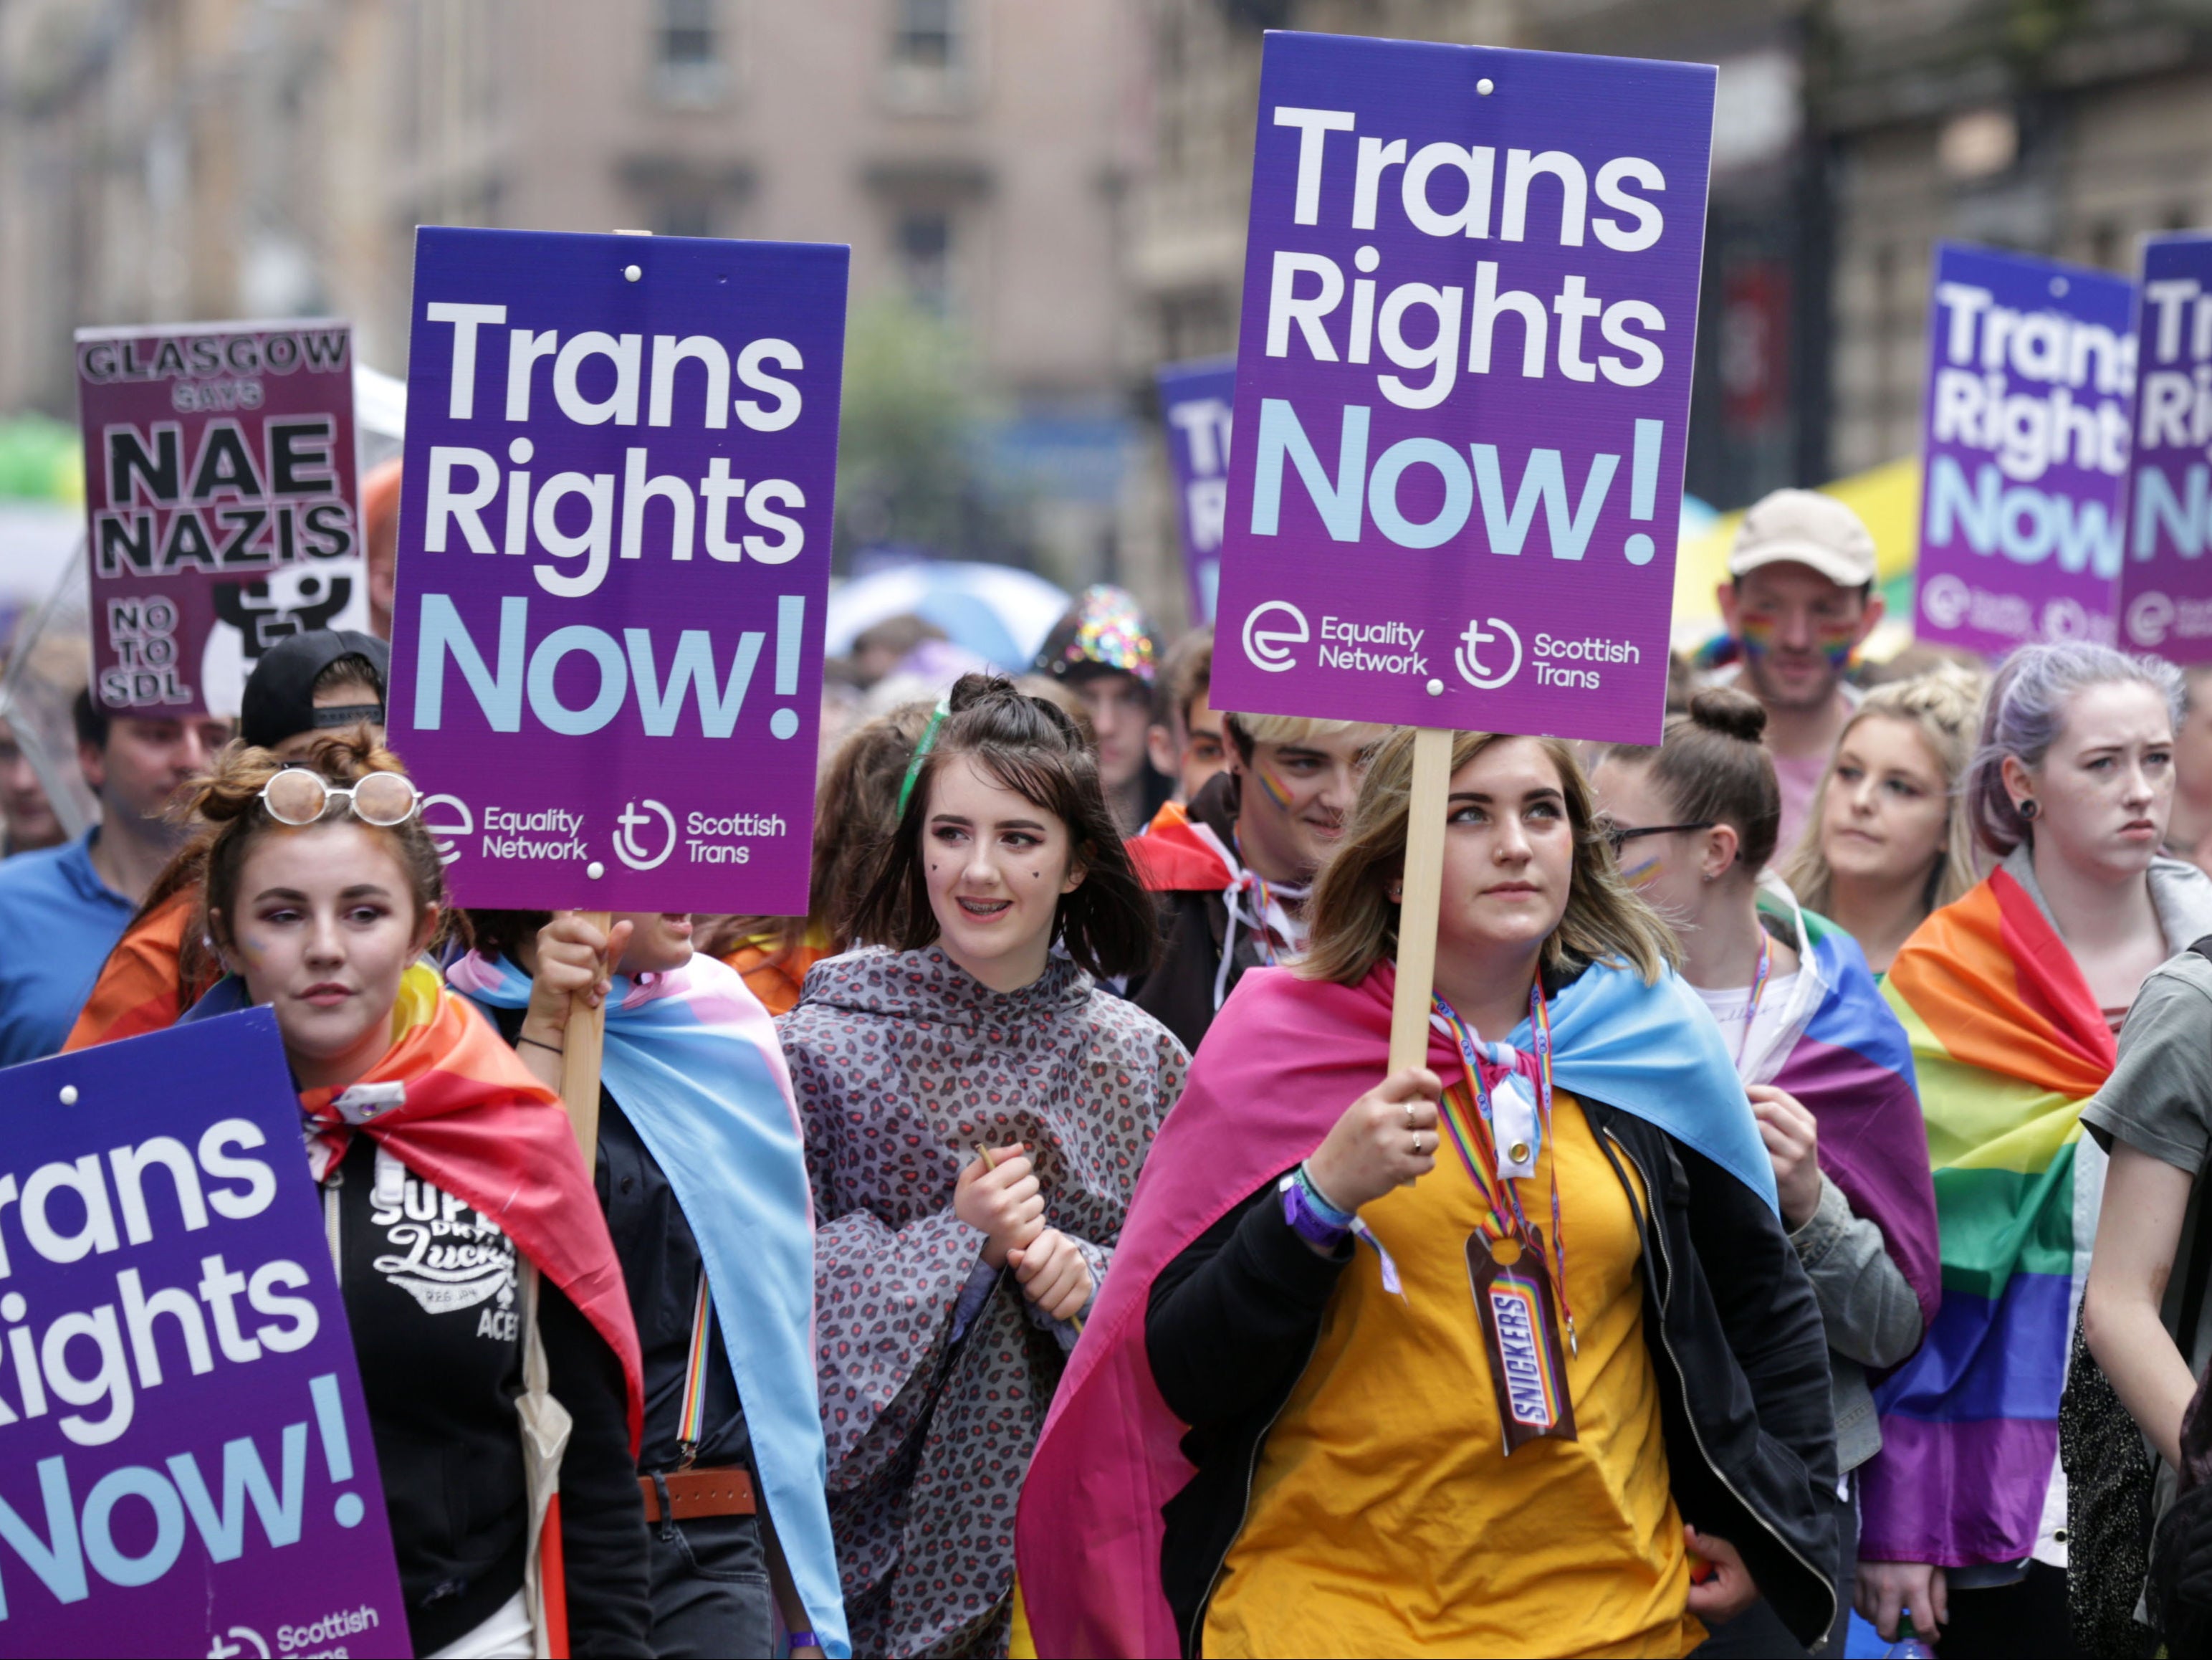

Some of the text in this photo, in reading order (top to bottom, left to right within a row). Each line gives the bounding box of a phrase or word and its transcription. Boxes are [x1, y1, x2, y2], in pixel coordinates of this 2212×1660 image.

[1273, 106, 1666, 252] Trans
[1265, 245, 1666, 410] Rights
[1936, 281, 2137, 399] Tran
[82, 333, 350, 382] GLASGOW
[426, 302, 804, 432] Trans
[173, 379, 264, 411] SAYS
[105, 416, 337, 507] NAE
[1250, 398, 1665, 566] Now!
[96, 502, 353, 576] NAZIS
[423, 437, 806, 598] Rights
[110, 599, 176, 637] NO
[1321, 616, 1425, 652] Equality
[115, 637, 176, 671] TO
[413, 593, 805, 740] Now!
[1318, 644, 1428, 675] Network
[1533, 633, 1640, 664] Scottish
[101, 669, 191, 707] SDL
[1532, 661, 1600, 690] Trans
[484, 806, 584, 838] Equality
[687, 811, 786, 836] Scottish
[482, 835, 588, 860] Network
[685, 839, 750, 864] Trans
[0, 1254, 319, 1446] ights
[1494, 1297, 1547, 1422] SNICKERS
[277, 1604, 379, 1651] Scottish
